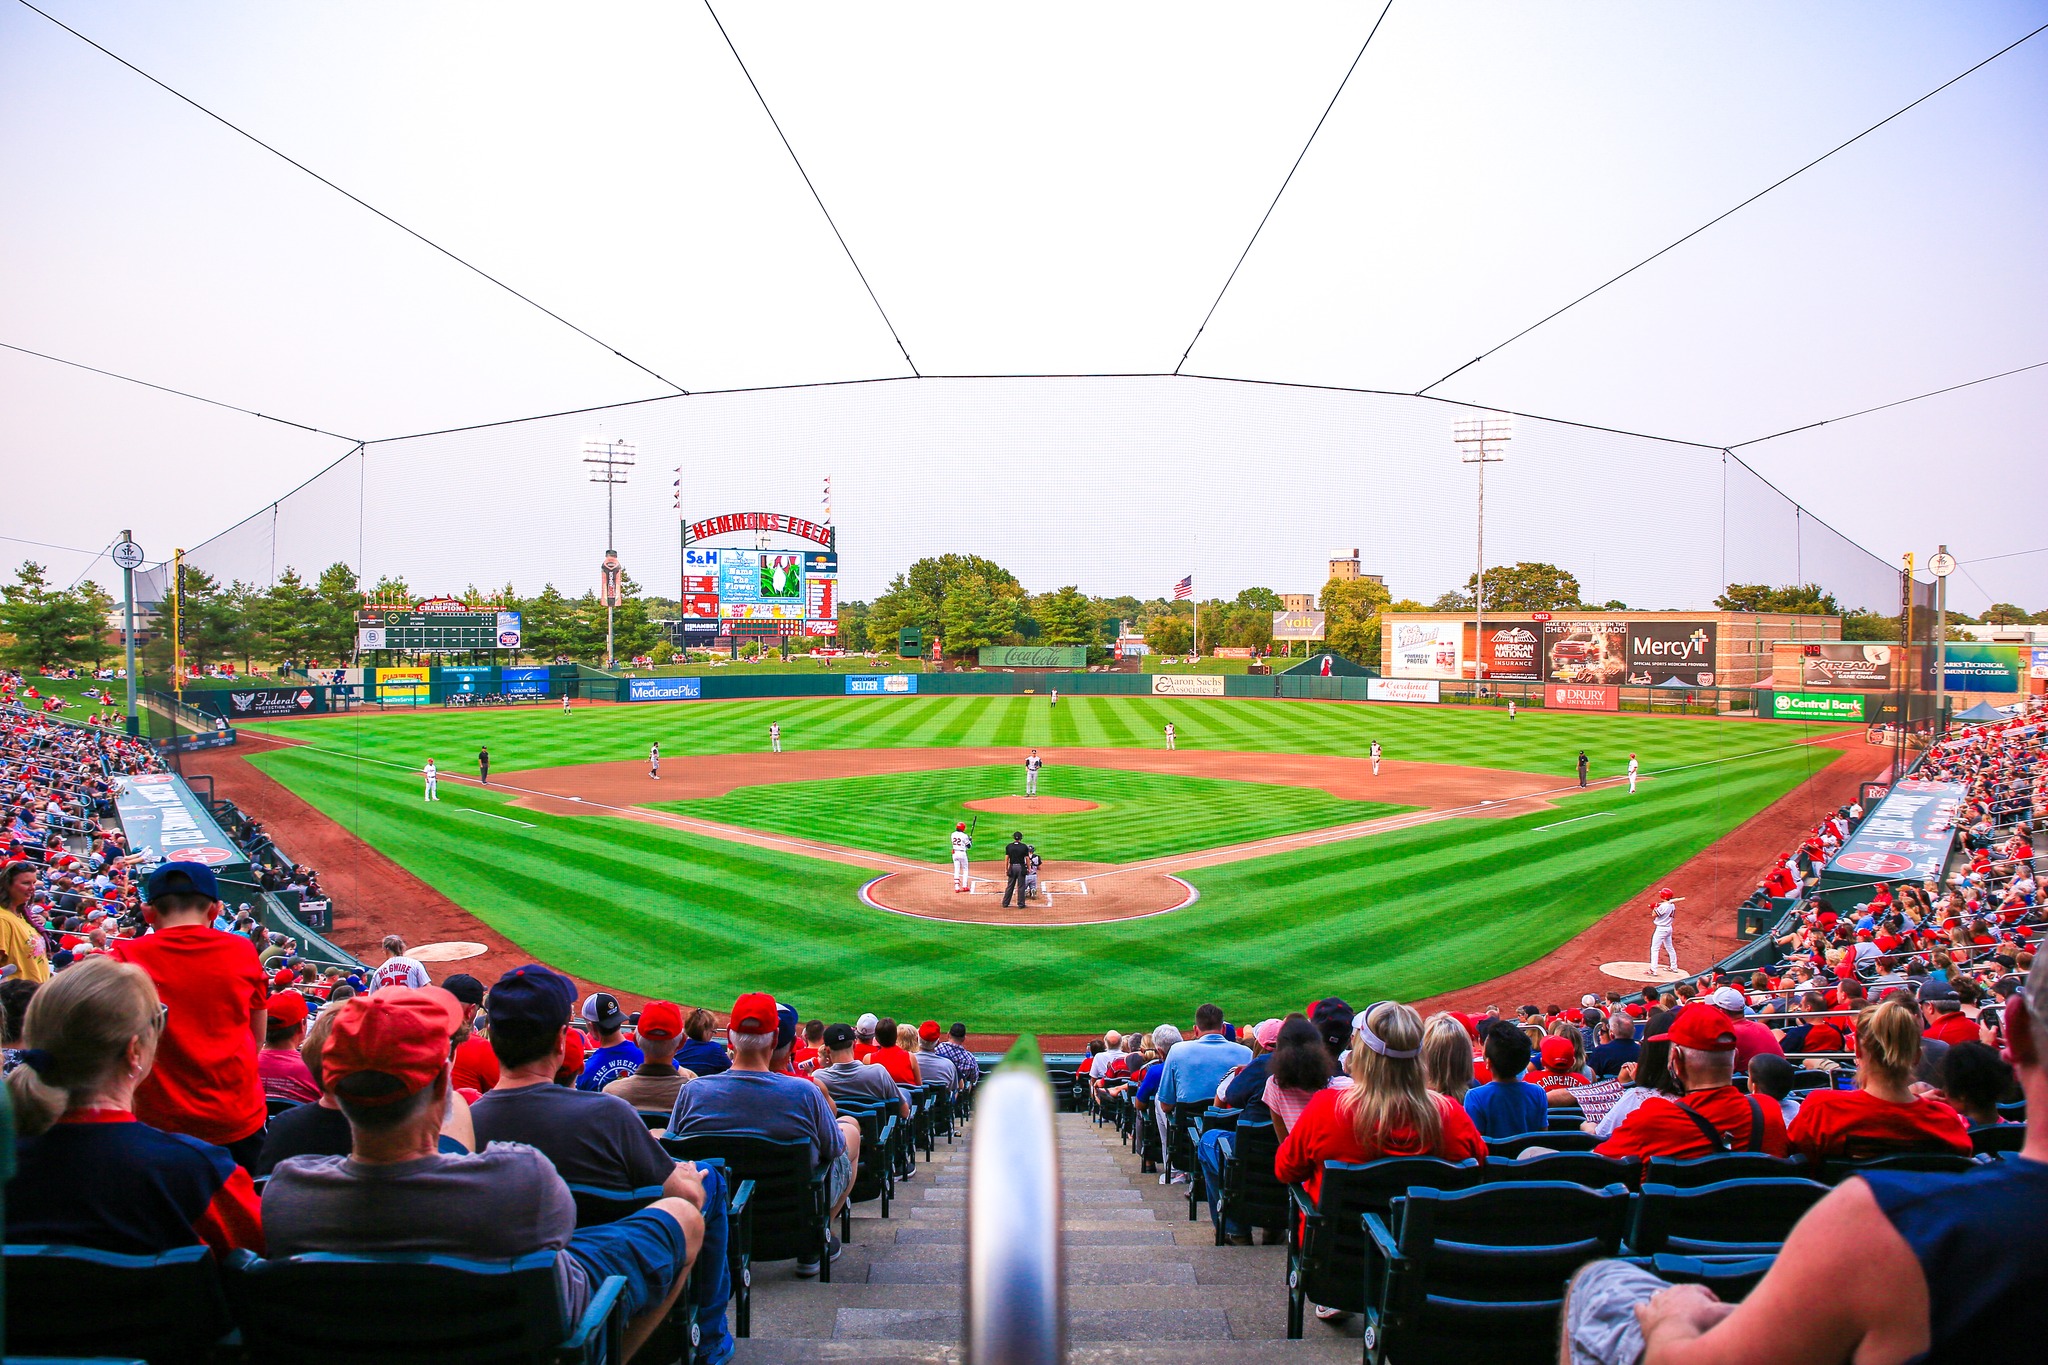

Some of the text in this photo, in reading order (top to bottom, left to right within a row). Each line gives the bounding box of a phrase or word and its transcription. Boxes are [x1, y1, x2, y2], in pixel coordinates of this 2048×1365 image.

[692, 513, 831, 545] HAMMONS FIELD
[686, 550, 717, 565] S&H
[1285, 615, 1313, 628] volt
[1494, 643, 1534, 651] AMERICAN
[1633, 636, 1693, 660] Mercy
[1004, 647, 1061, 666] Coca-Cola
[1495, 650, 1533, 658] NATIONAL
[1810, 659, 1877, 678] XTREAM
[851, 681, 878, 691] SELTZER
[1167, 677, 1222, 686] Aaron Sachs
[1386, 681, 1430, 690] Cardinal
[631, 684, 699, 698] MedicarePlus
[1386, 690, 1427, 699] Roofing
[1567, 689, 1606, 699] DRURY
[256, 690, 297, 706] Federal
[1791, 698, 1862, 711] Central Bank
[953, 837, 962, 846] 22
[388, 963, 412, 975] GWIRE
[592, 1065, 608, 1083] THE
